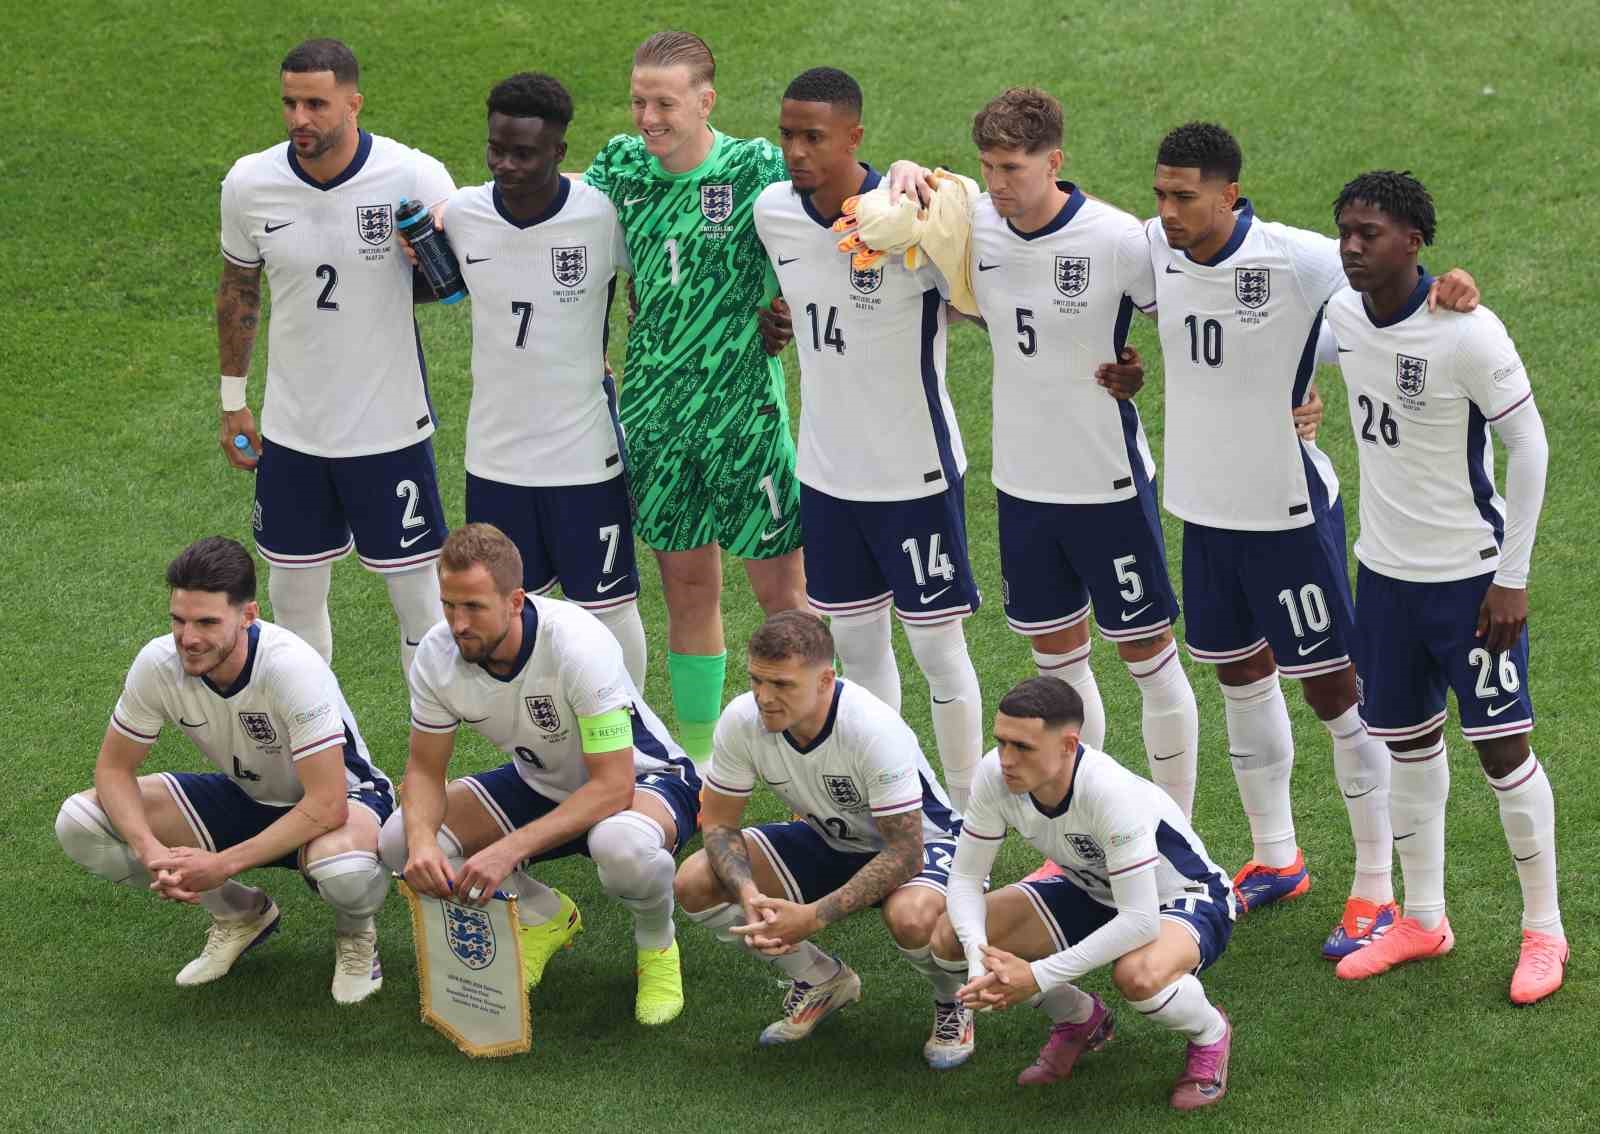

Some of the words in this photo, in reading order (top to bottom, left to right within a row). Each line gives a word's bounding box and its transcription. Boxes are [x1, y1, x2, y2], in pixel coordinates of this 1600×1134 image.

[315, 263, 340, 312] 2
[663, 239, 679, 287] 1
[511, 301, 534, 350] 7
[805, 302, 847, 356] 14
[1015, 307, 1038, 358] 5
[1184, 314, 1224, 369] 10
[1357, 394, 1401, 449] 26
[395, 479, 426, 529] 2
[758, 474, 783, 522] 1
[599, 523, 621, 575] 7
[901, 533, 956, 586] 14
[1112, 554, 1144, 603] 5
[1278, 583, 1331, 638] 10
[1468, 647, 1521, 699] 26
[232, 754, 262, 782] 4
